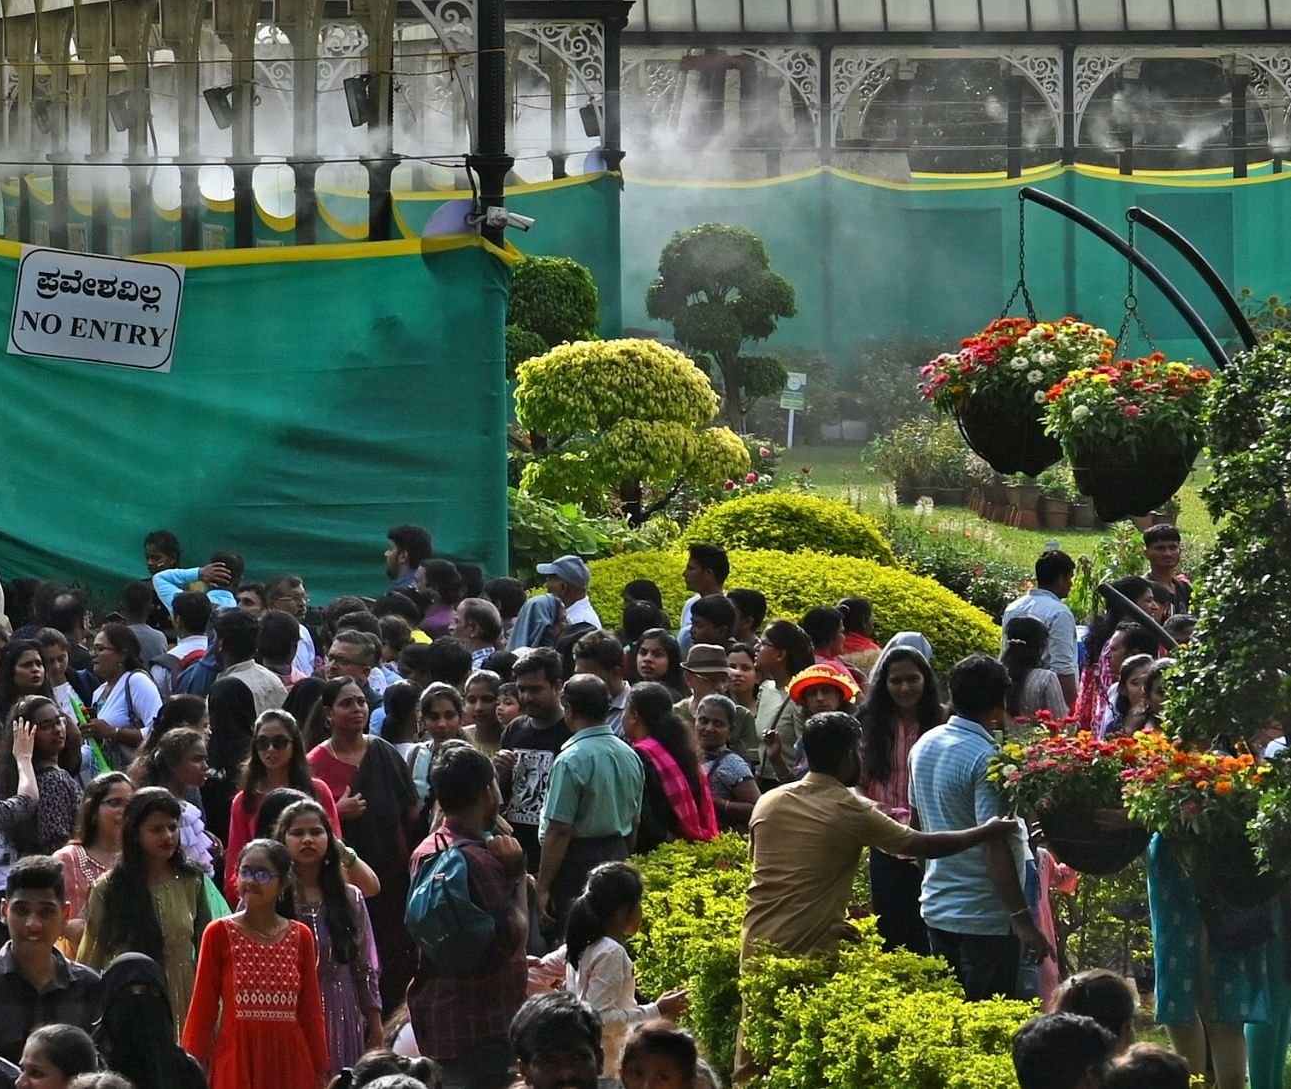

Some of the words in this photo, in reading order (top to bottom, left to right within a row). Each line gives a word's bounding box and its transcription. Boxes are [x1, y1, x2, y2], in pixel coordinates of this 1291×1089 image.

[36, 266, 162, 313] ಪ್ರವೇಶವಿಲ್ಲ
[19, 310, 62, 335] NO
[69, 317, 168, 348] ENTRY
